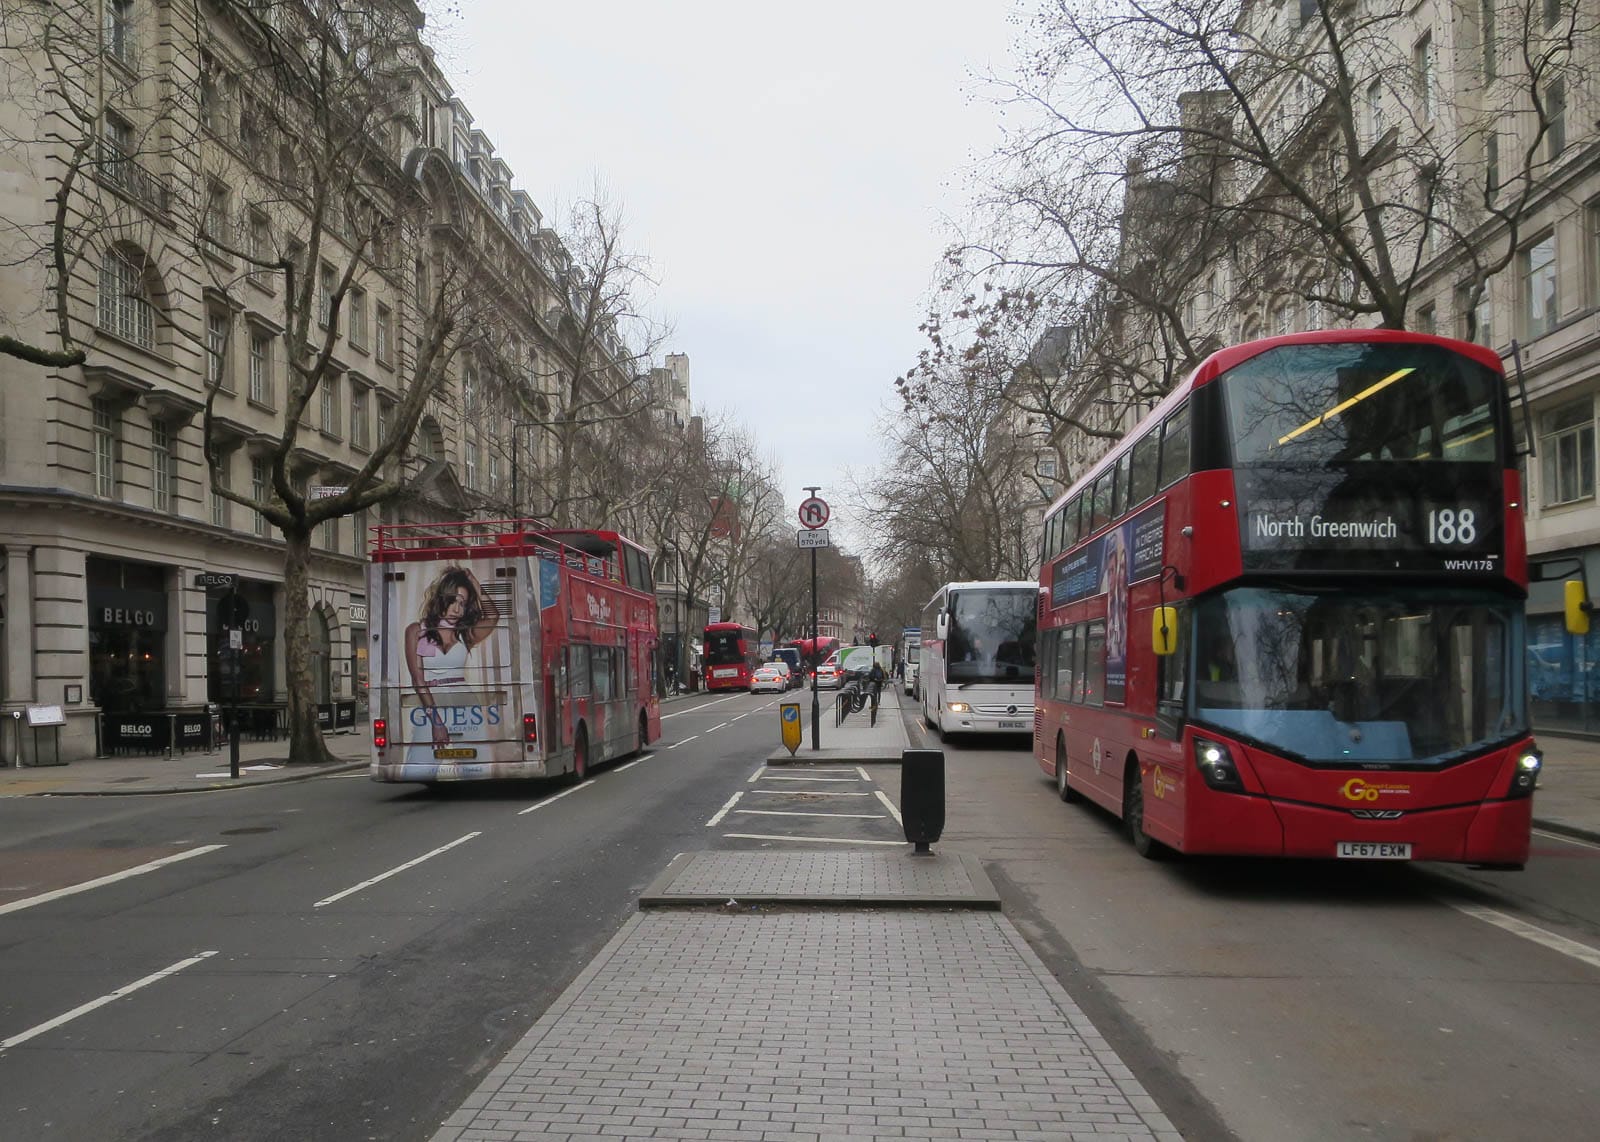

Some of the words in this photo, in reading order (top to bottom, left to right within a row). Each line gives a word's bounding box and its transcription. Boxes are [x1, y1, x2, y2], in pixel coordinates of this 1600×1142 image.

[1256, 516, 1304, 538] North
[1310, 515, 1397, 538] Greenwich
[1429, 508, 1476, 545] 188
[1444, 560, 1493, 571] WHV178
[104, 607, 154, 626] BELGO
[410, 705, 500, 726] GUESS
[120, 724, 152, 734] BELGO
[183, 724, 201, 734] BELGO
[1344, 777, 1379, 801] Go
[1342, 843, 1377, 856] LF67
